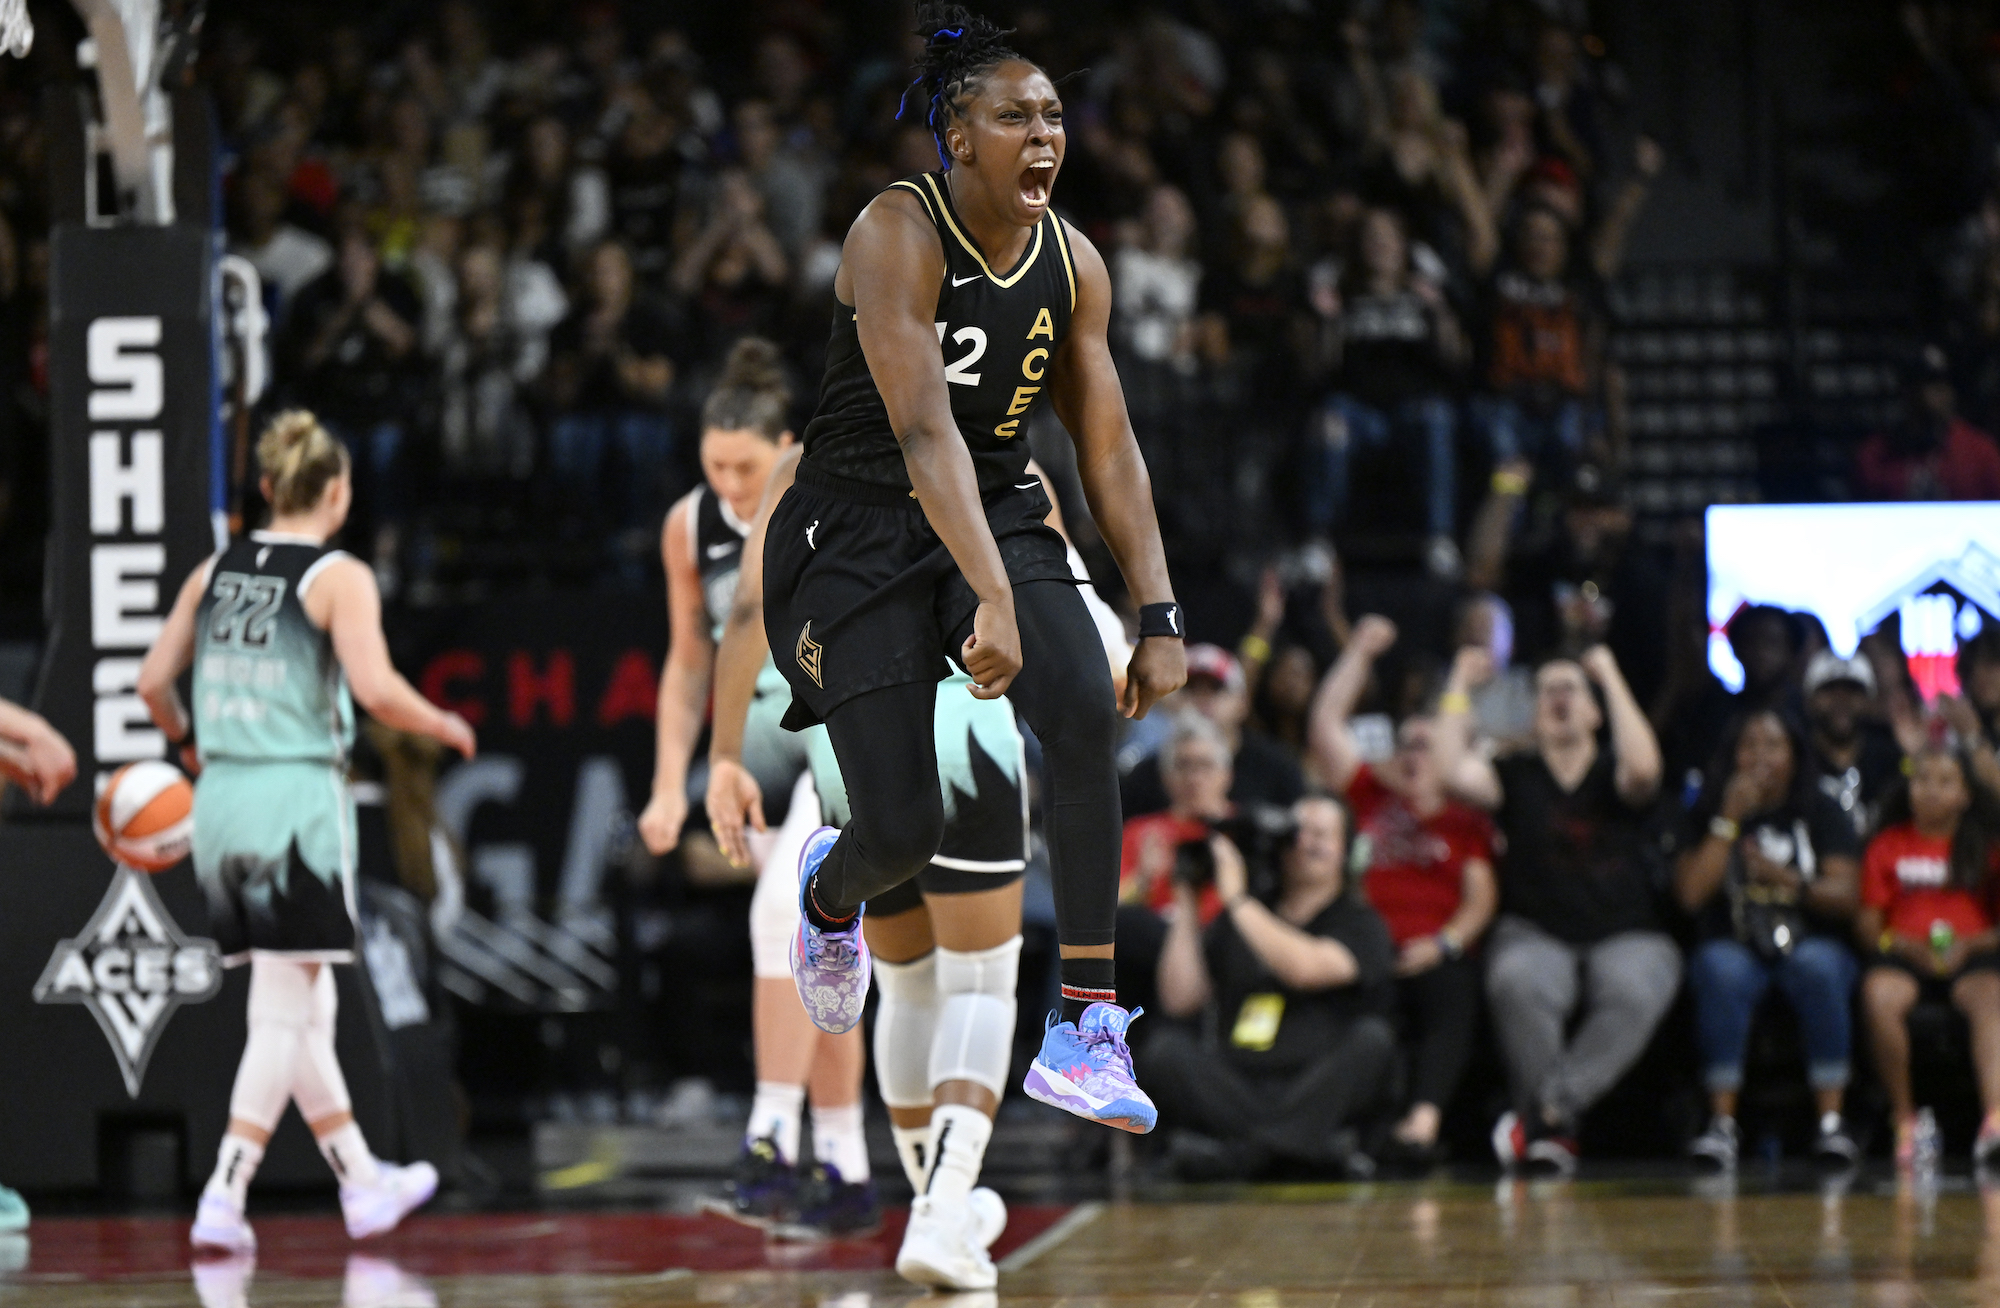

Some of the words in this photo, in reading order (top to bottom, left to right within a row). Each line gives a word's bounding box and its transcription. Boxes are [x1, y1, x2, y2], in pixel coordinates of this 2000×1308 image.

[994, 307, 1054, 440] ACES
[213, 571, 288, 651] 22
[419, 648, 713, 728] CHA
[54, 945, 211, 994] ACES
